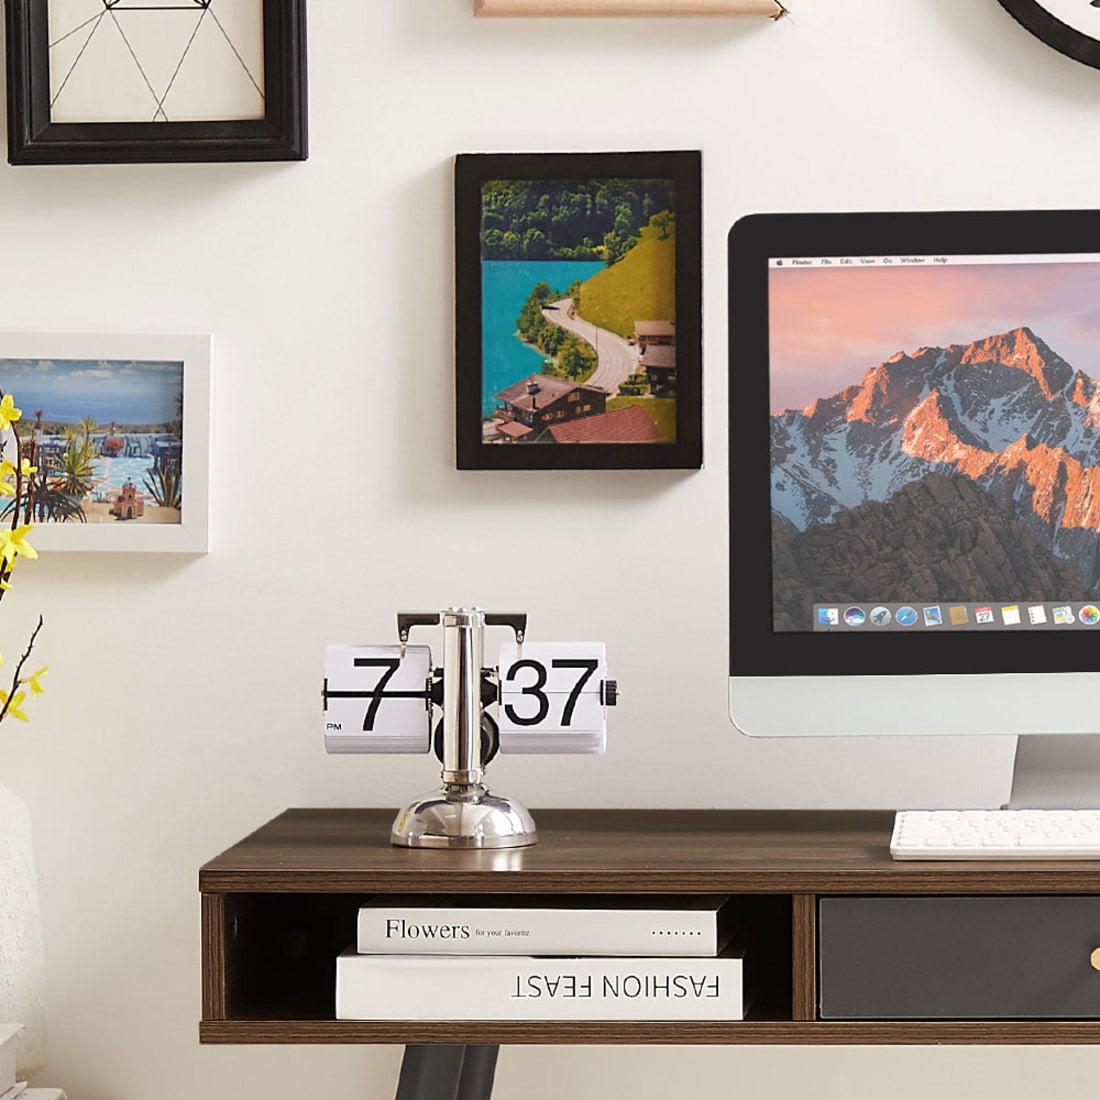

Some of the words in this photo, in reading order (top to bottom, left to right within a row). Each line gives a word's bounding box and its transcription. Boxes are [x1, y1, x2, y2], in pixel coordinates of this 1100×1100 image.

[933, 257, 948, 265] Help
[353, 657, 400, 732] 7
[503, 658, 599, 727] 37
[326, 723, 342, 731] PM
[385, 919, 470, 939] Flowers
[511, 975, 592, 998] FEAST
[603, 975, 720, 998] FASHION
